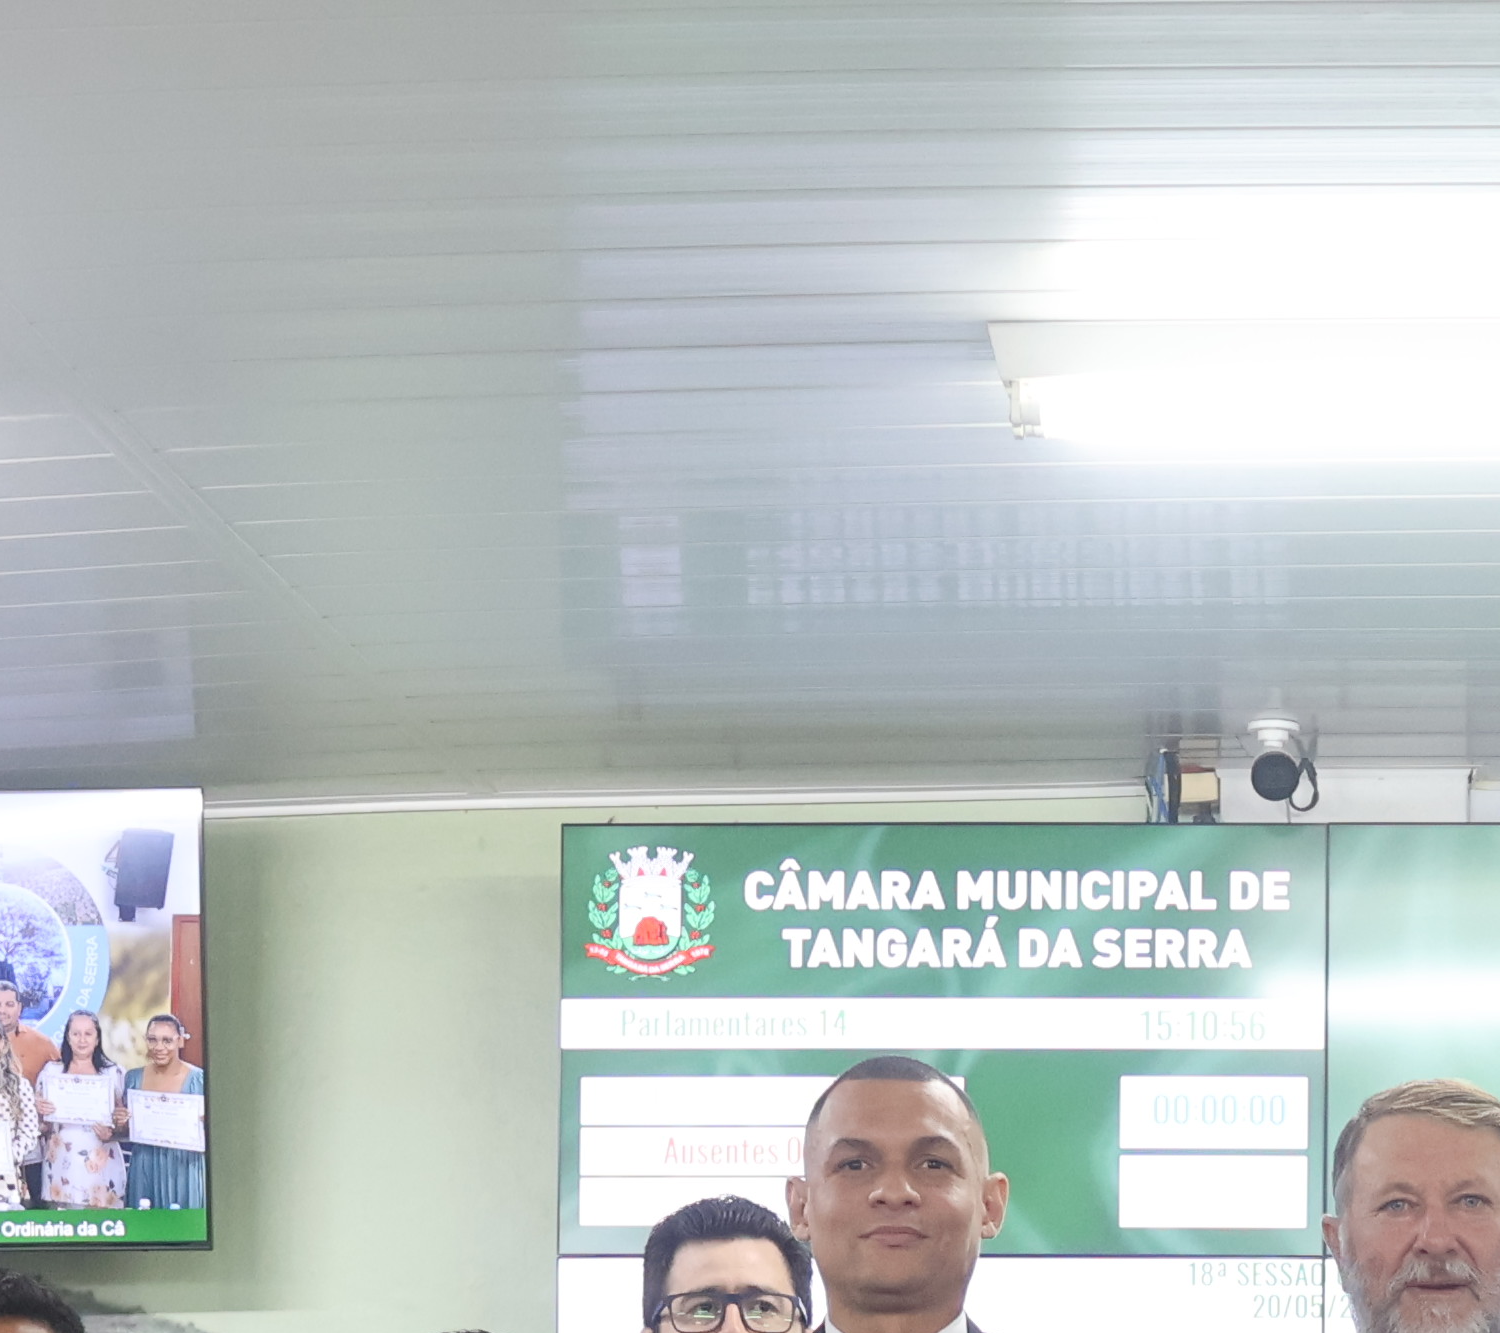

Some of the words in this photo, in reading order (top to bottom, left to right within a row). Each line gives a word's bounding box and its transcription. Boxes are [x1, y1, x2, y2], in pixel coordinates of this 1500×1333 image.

[744, 859, 945, 911] CÂMARA
[956, 870, 1216, 911] MUNICIPAL
[1229, 870, 1291, 911] DE
[782, 917, 1004, 969] TANGARÁ
[1017, 928, 1083, 969] DA
[1092, 928, 1253, 969] SERRA
[620, 1009, 808, 1039] Parlamentares
[819, 1009, 847, 1038] 14
[1141, 1010, 1266, 1042] 15:10:56
[664, 1136, 778, 1165] Ausentes
[2, 1221, 74, 1238] Ordinária
[77, 1221, 99, 1238] da
[102, 1220, 125, 1237] Câ
[1189, 1262, 1227, 1287] 18ª
[1253, 1294, 1352, 1319] 20/05/2
